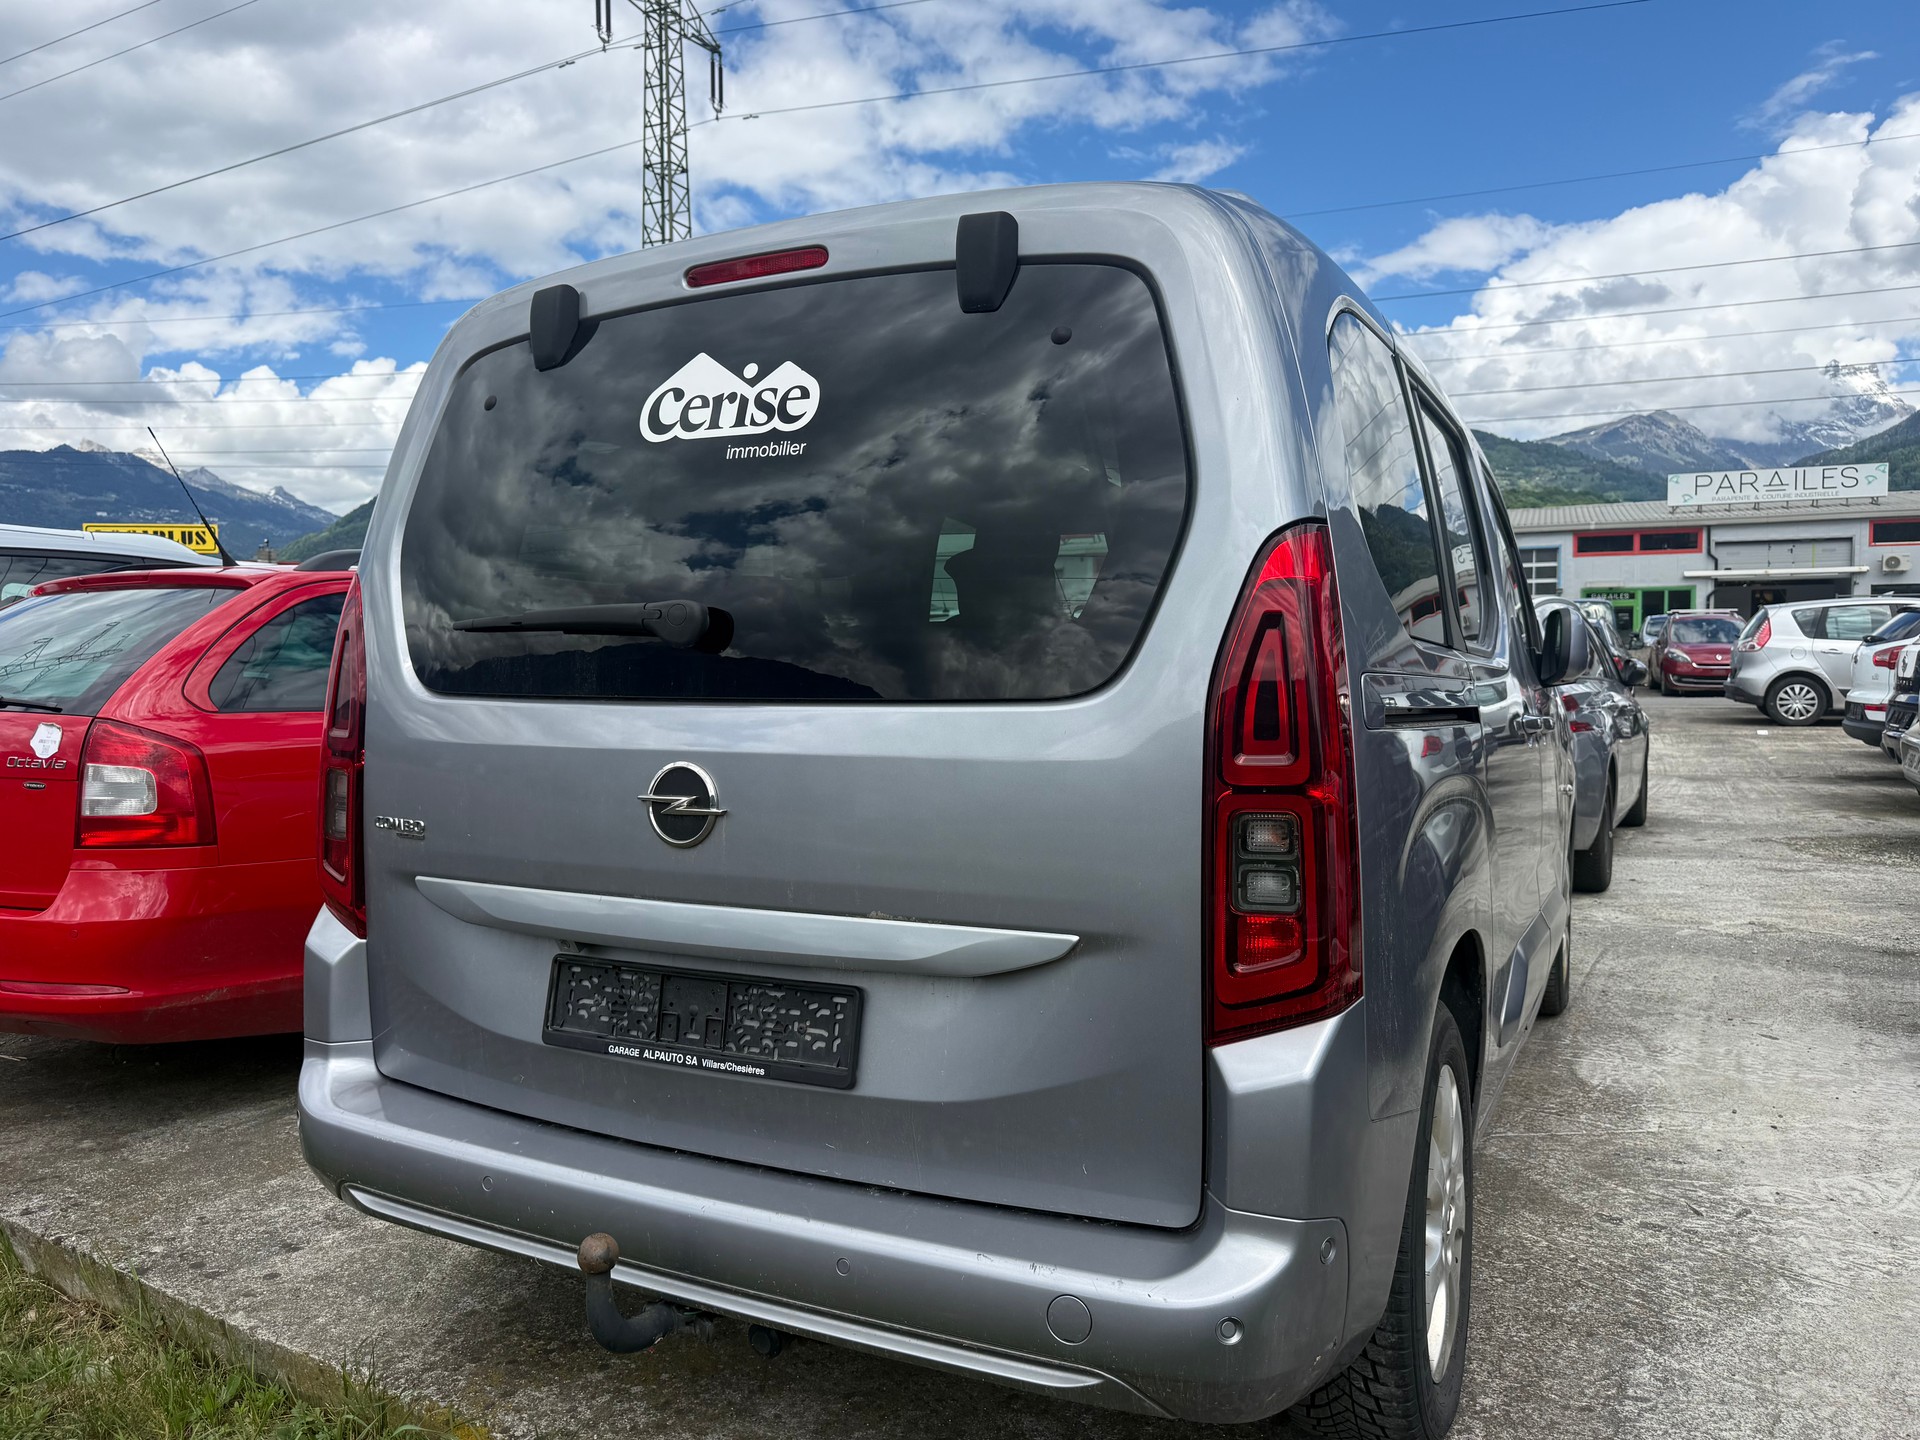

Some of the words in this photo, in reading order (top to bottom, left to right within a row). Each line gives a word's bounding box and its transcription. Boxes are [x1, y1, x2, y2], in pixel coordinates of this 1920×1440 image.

[726, 440, 807, 460] immobilier
[1694, 467, 1859, 495] PARAILES
[1761, 492, 1793, 500] COUTURE
[1794, 490, 1840, 499] INDUSTRIELLE
[6, 756, 67, 769] Octavia
[608, 1044, 640, 1057] GARAGE
[643, 1049, 684, 1064] ALPAUTO
[685, 1055, 698, 1066] SA
